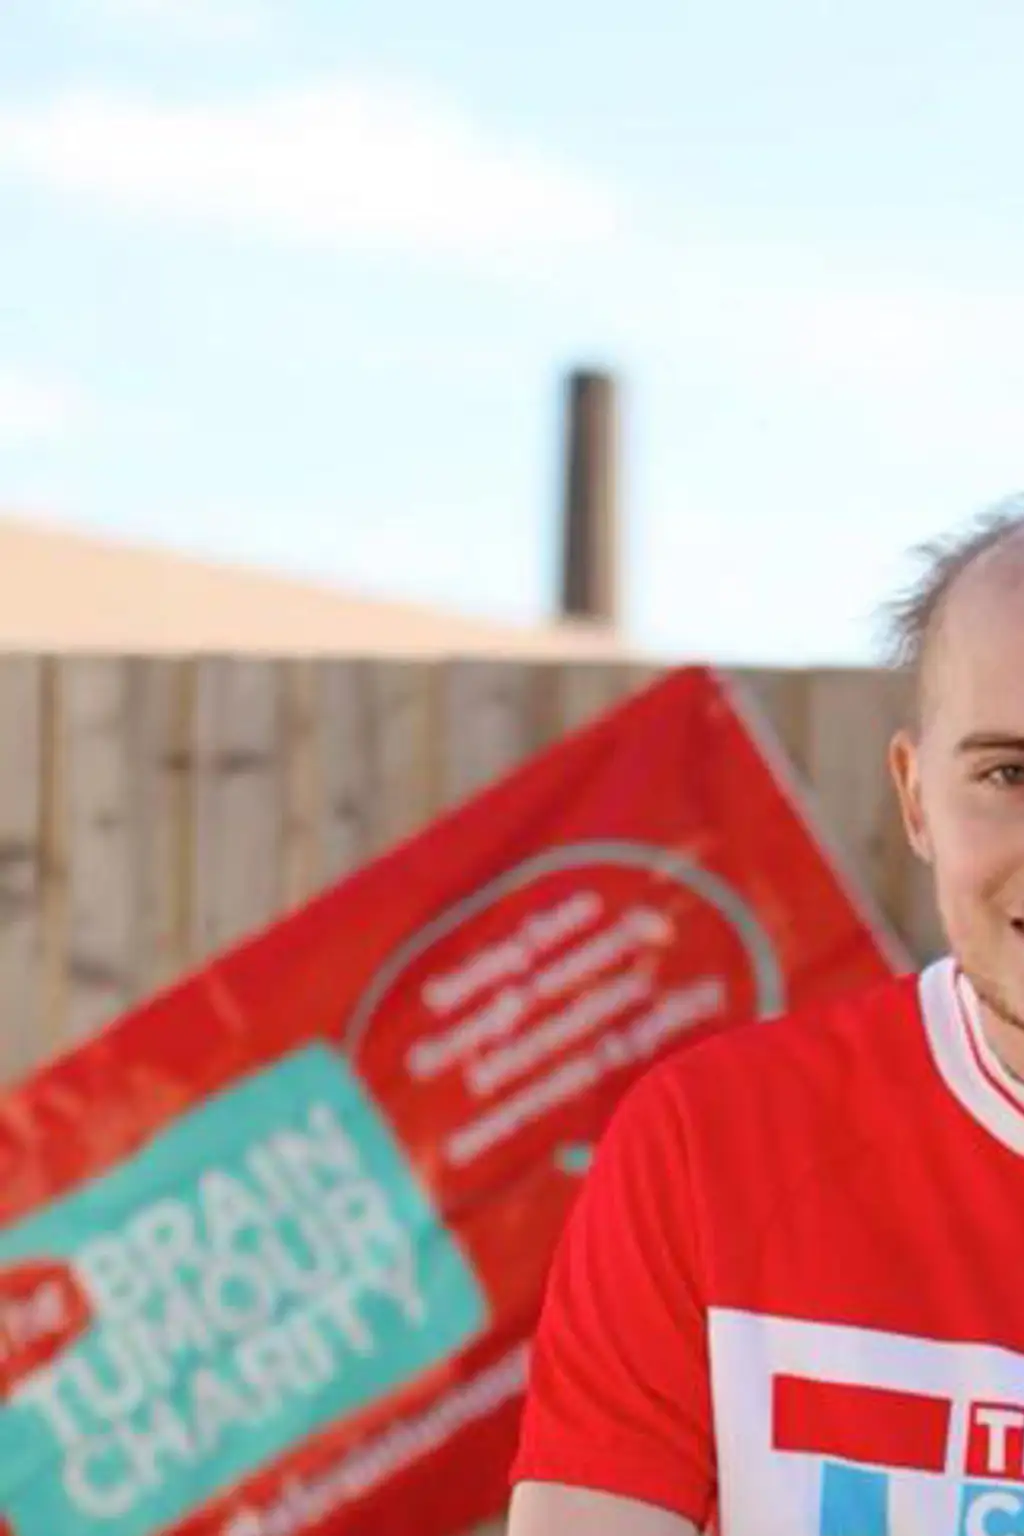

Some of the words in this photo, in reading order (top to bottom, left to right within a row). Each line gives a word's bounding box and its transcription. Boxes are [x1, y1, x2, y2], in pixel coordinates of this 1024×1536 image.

[9, 1174, 404, 1453] TUMOUR
[73, 1102, 365, 1318] BRAIN
[60, 1240, 423, 1516] CHARITY
